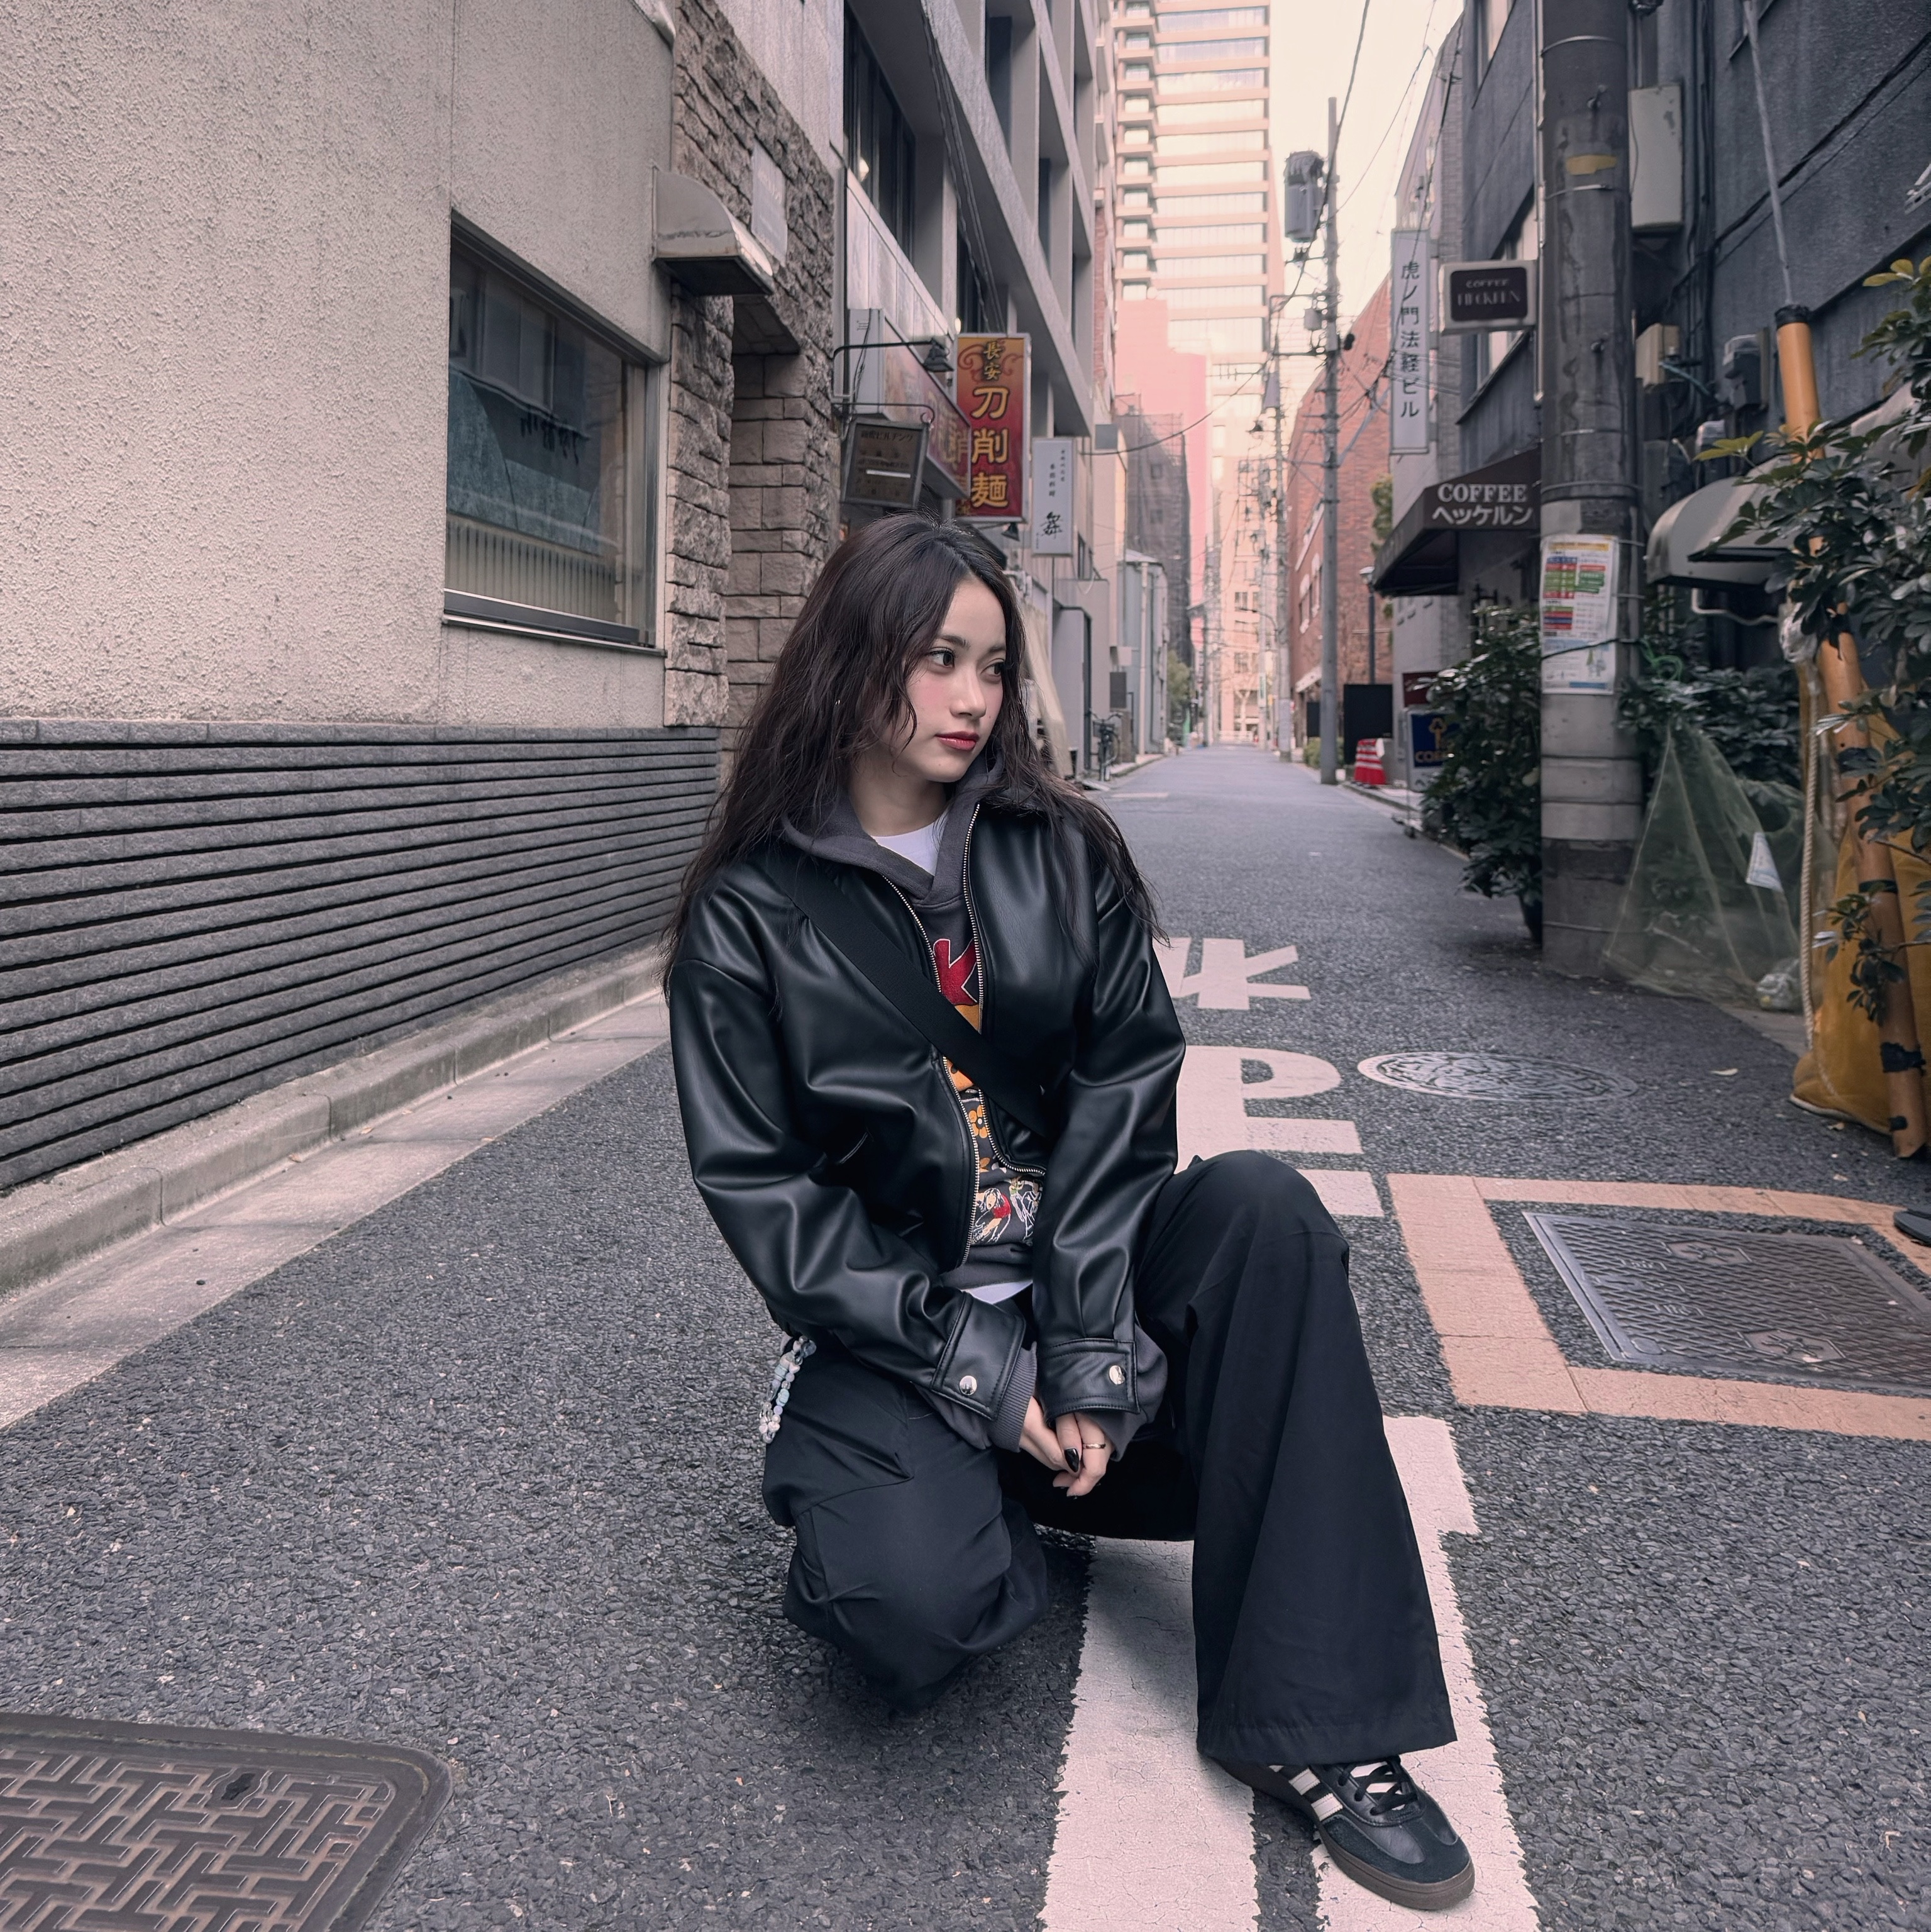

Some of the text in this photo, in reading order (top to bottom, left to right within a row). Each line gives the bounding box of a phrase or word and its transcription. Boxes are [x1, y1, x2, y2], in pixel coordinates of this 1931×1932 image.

[1466, 278, 1510, 289] COFFEE
[1400, 261, 1420, 418] 虎ノ門法経ビル
[983, 341, 1003, 381] 長安
[970, 387, 1009, 508] 刀削麺
[1437, 482, 1528, 502] COFFEE
[1432, 504, 1534, 526] ヘッケルン
